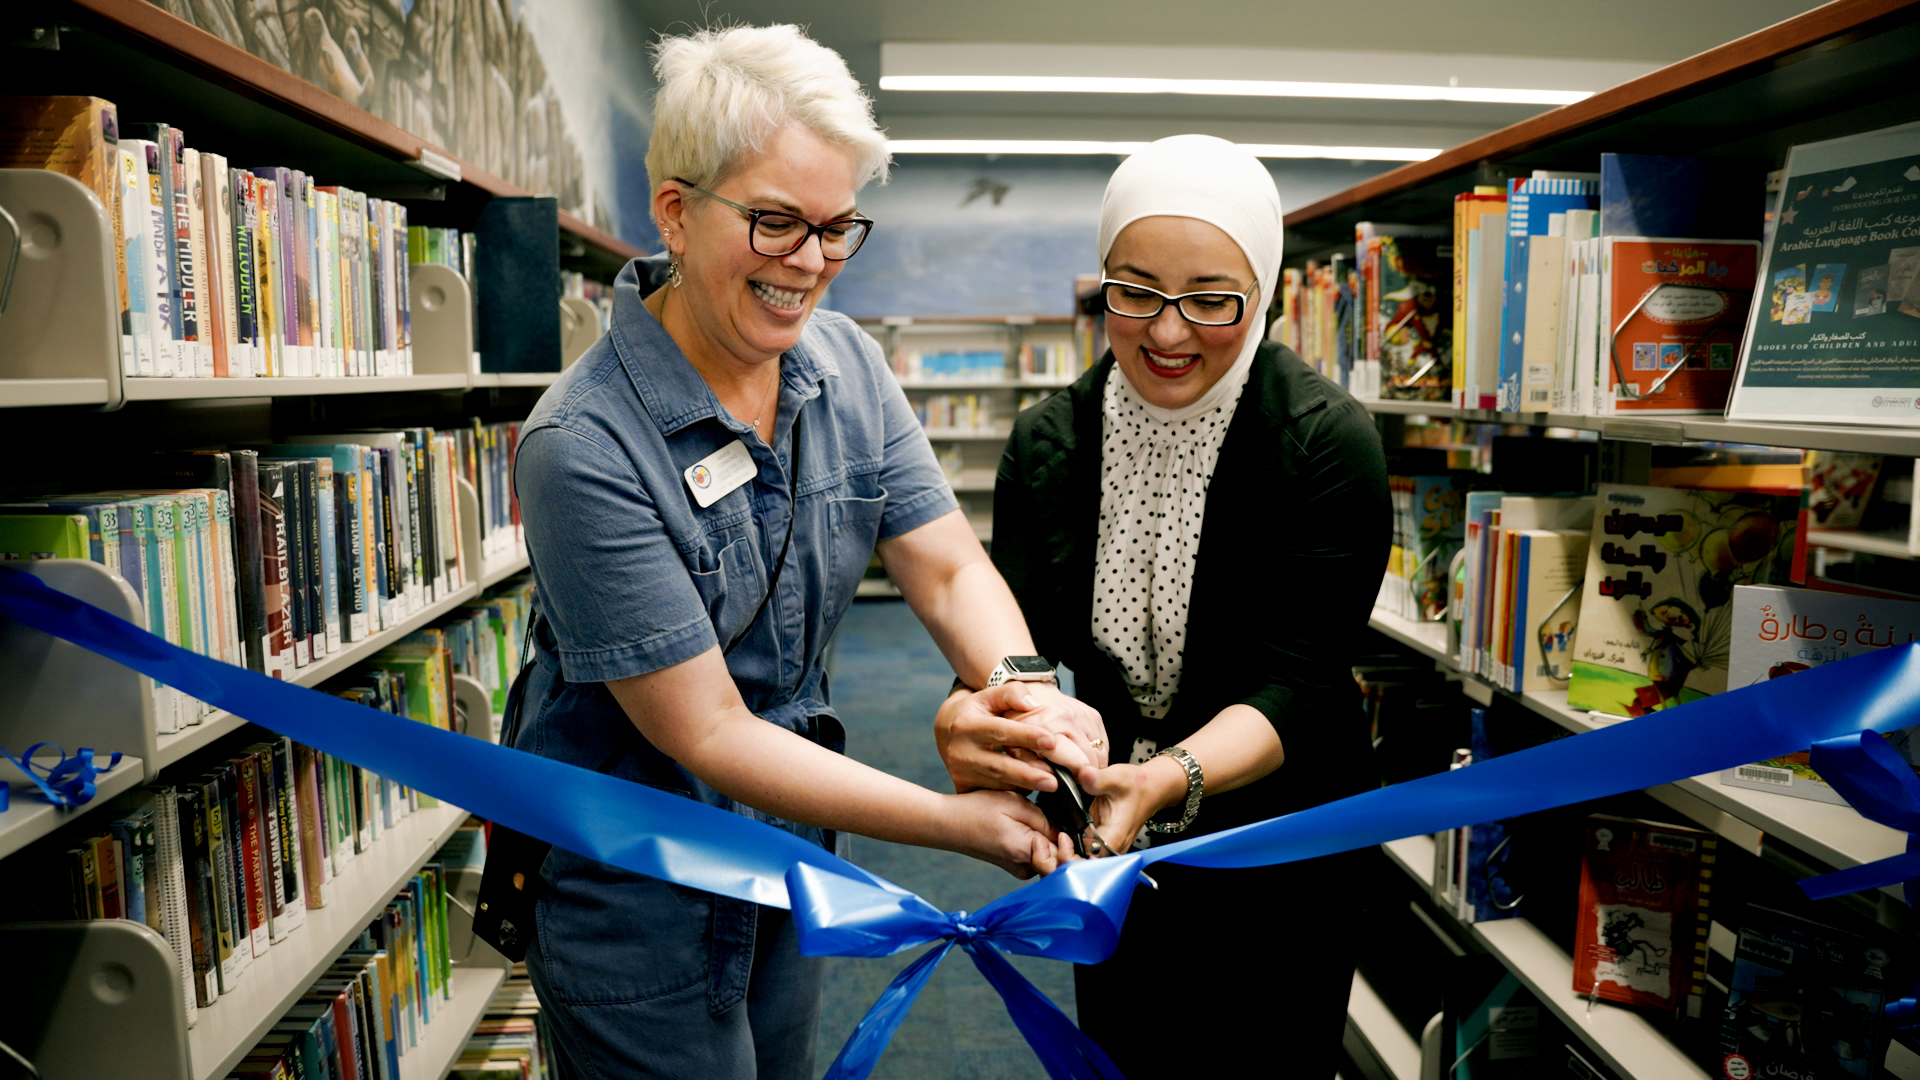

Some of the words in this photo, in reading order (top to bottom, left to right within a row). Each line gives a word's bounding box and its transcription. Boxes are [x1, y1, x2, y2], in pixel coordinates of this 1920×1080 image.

[176, 193, 189, 229] THE
[1832, 198, 1882, 212] INTRODUCING
[1882, 196, 1901, 205] OUR
[1901, 193, 1917, 202] NEW
[151, 210, 165, 258] MAYBE
[1780, 239, 1813, 252] Arabic
[1814, 233, 1867, 249] Language
[1868, 230, 1899, 242] Book
[157, 264, 168, 285] A
[179, 238, 198, 322] MIDDLER
[236, 225, 252, 314] WILLODEEN
[1641, 260, 1705, 277] المركبات
[1706, 261, 1728, 278] مع
[157, 293, 171, 331] FOX
[1813, 342, 1861, 350] CHILDREN
[351, 519, 360, 554] ISLAND
[275, 510, 292, 645] TRAILBLAZER
[352, 566, 363, 611] BEYOND
[249, 823, 258, 847] THE
[268, 807, 281, 868] FENWAY
[280, 817, 289, 836] Creek
[281, 836, 290, 862] Library
[251, 849, 262, 894] PARENT
[1614, 862, 1667, 895] طالب
[273, 870, 285, 909] PARK
